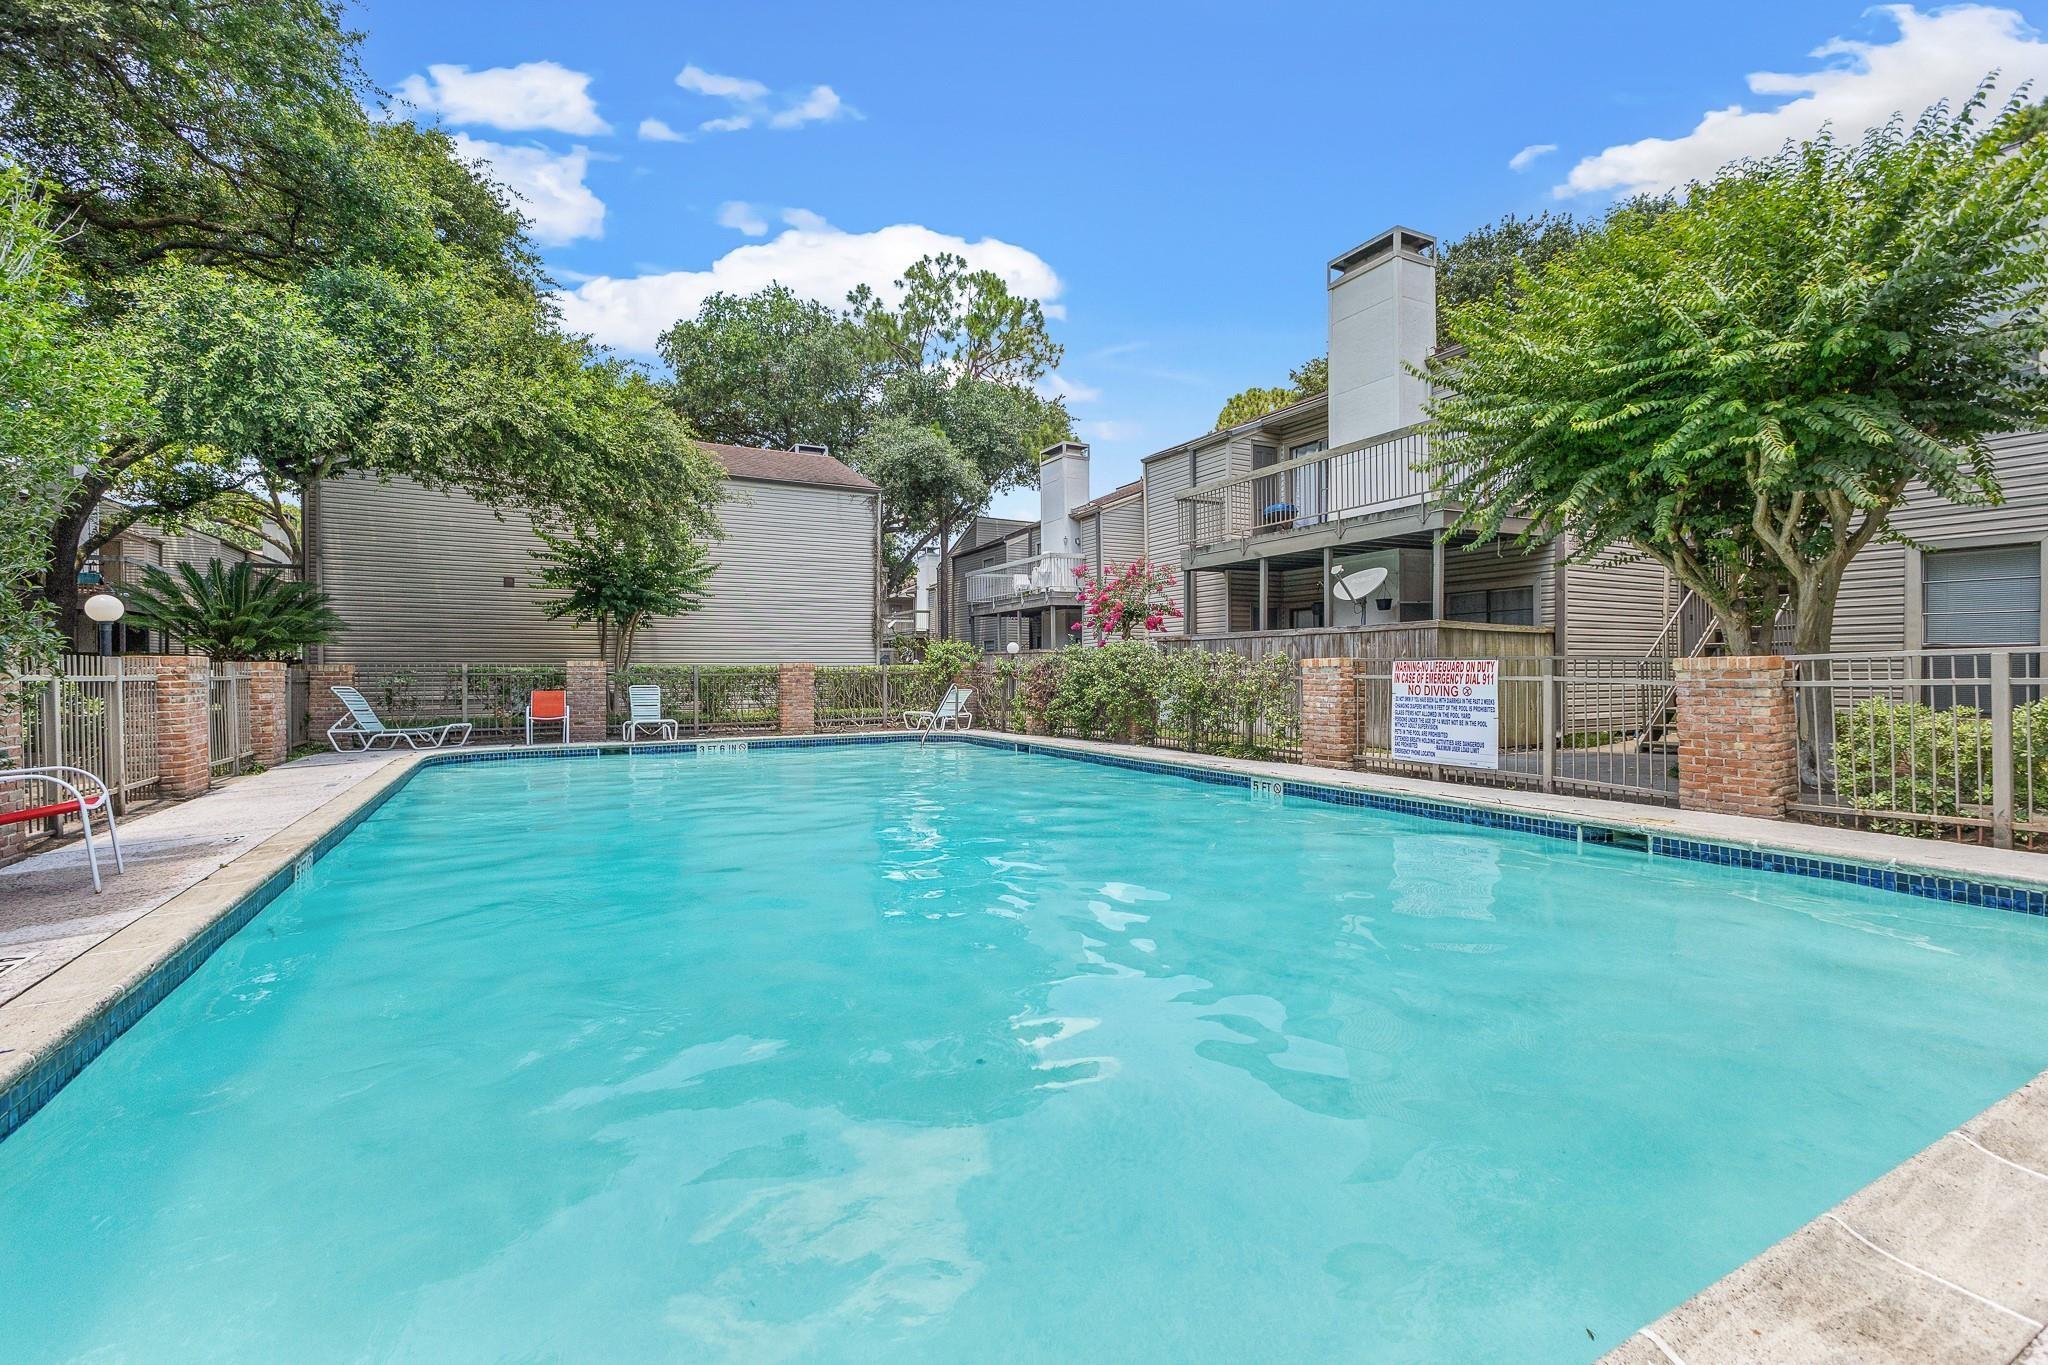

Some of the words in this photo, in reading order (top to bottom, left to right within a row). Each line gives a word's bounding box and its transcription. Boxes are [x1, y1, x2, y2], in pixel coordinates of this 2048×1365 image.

[1430, 661, 1464, 673] LIFEGUARD
[1465, 662, 1475, 673] ON
[1477, 662, 1495, 673] DUTY
[1394, 673, 1400, 684] IN
[1401, 673, 1416, 684] CASE
[1416, 673, 1424, 684] OF
[1425, 673, 1464, 685] EMERGENCY
[1465, 674, 1481, 685] DIAL
[1482, 674, 1495, 686] 911
[1407, 685, 1421, 696] NO
[1424, 685, 1459, 697] DIVING
[1477, 720, 1488, 728] POOL
[1436, 738, 1454, 746] ACTIVITIES
[1462, 740, 1485, 749] DANGEROUS
[1253, 781, 1259, 791] 5
[1261, 781, 1271, 792] FT
